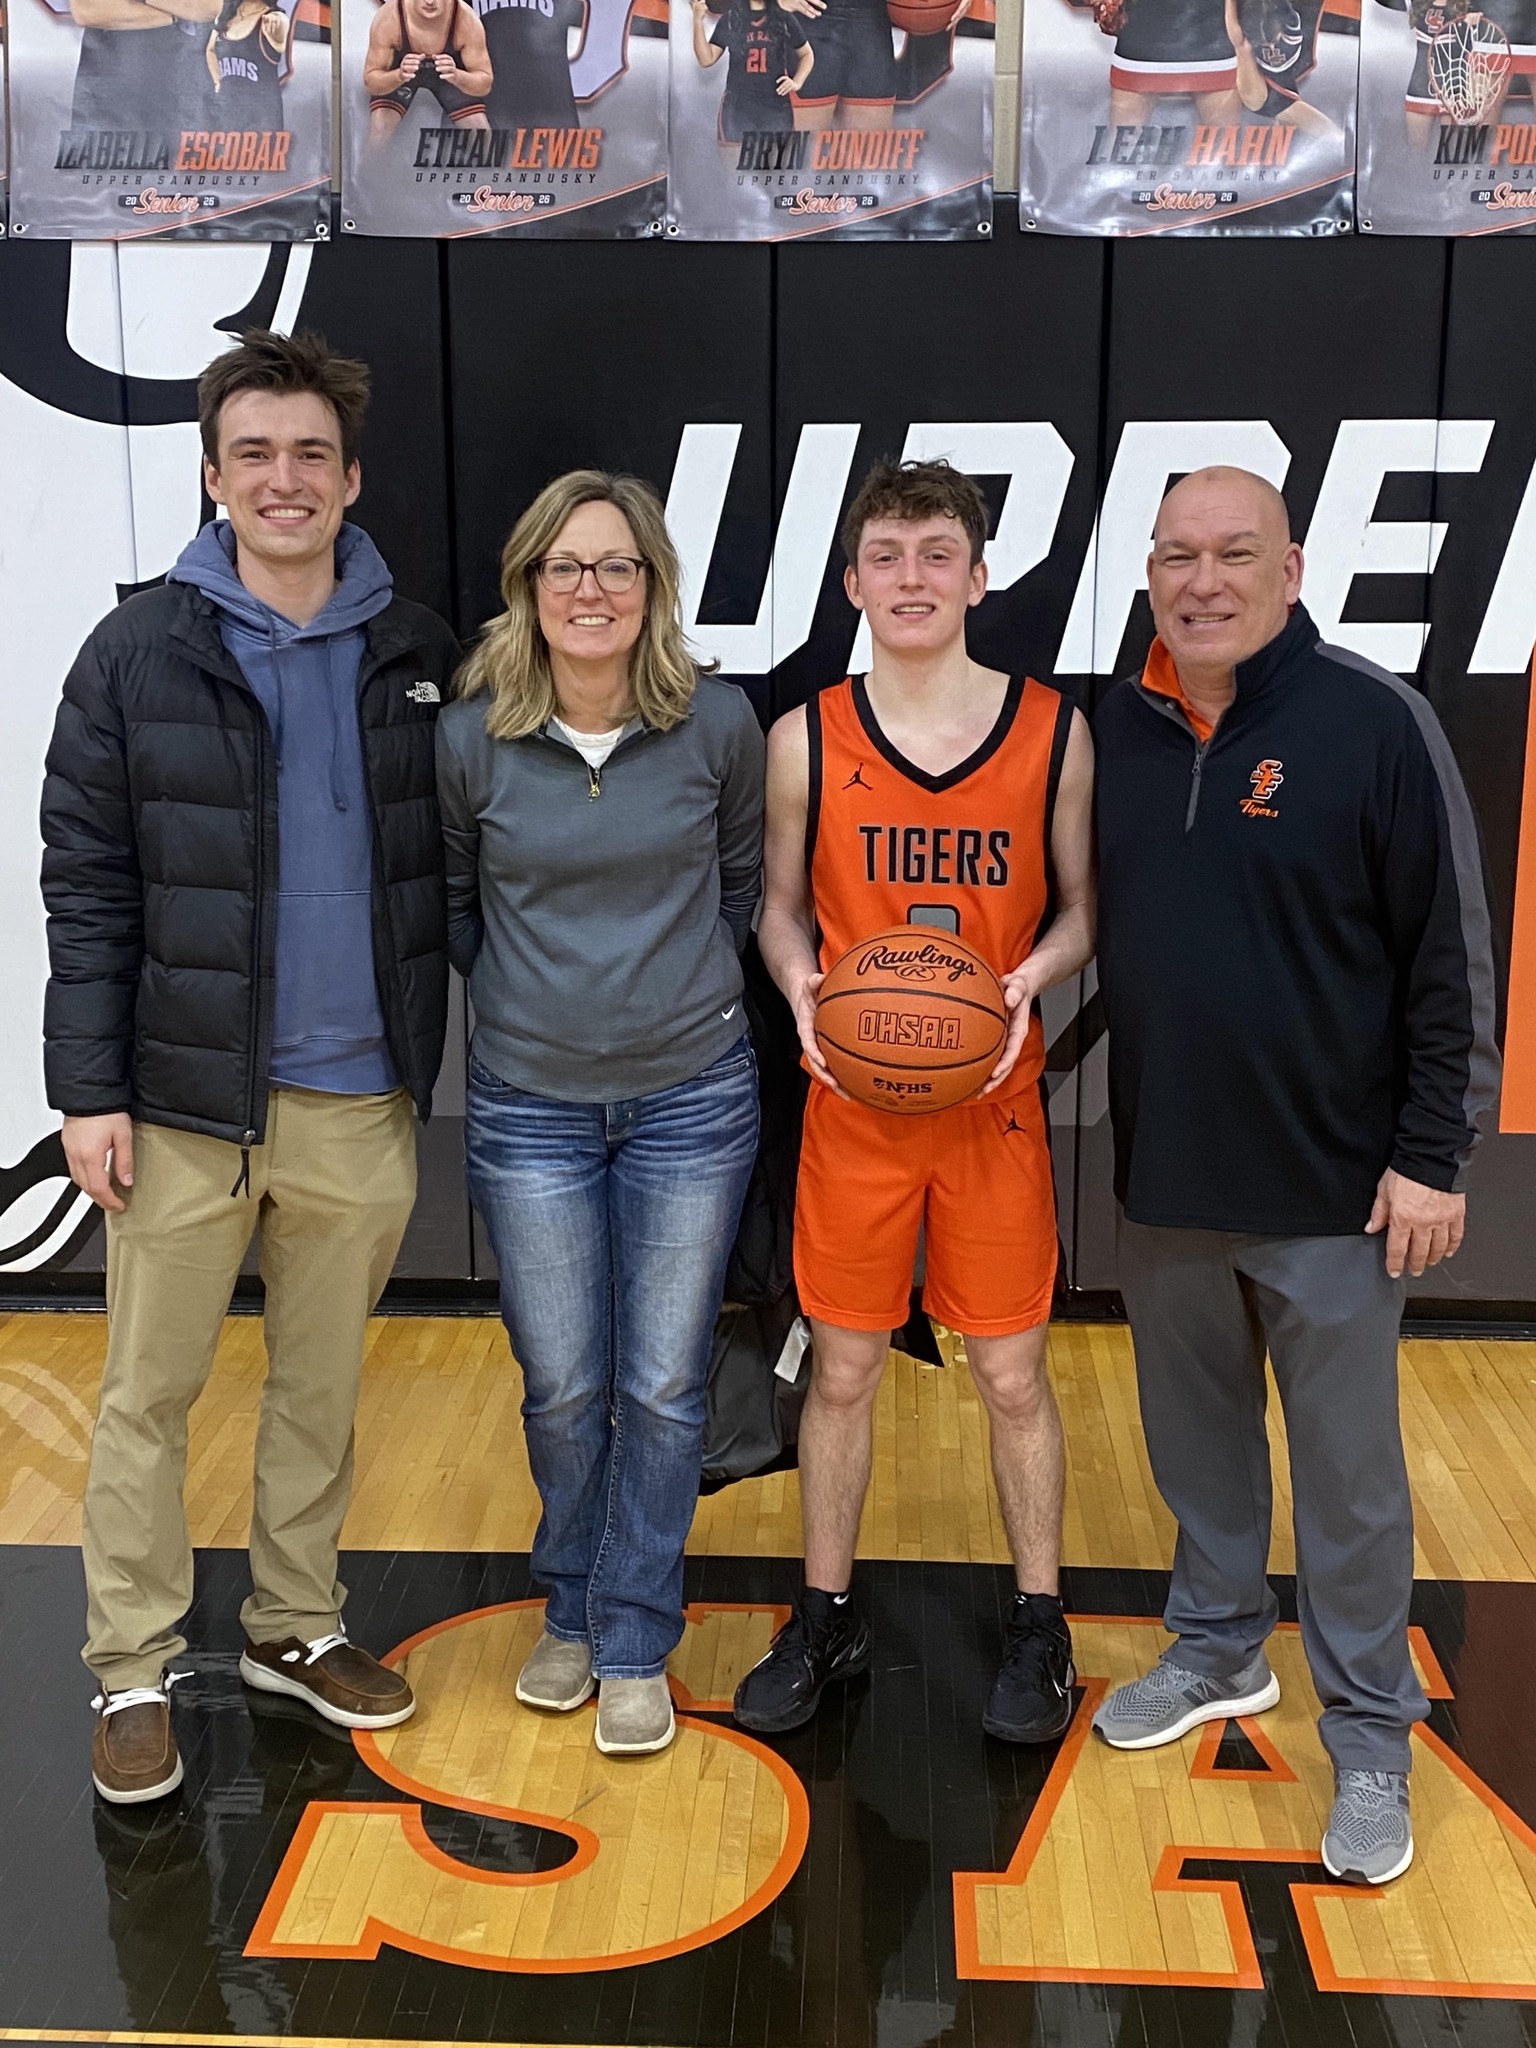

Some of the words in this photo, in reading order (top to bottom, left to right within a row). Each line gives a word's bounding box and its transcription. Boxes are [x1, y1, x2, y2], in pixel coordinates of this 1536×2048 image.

[746, 47, 767, 73] 21
[174, 131, 291, 172] ESCOBAR
[413, 128, 509, 168] ETHAN
[511, 128, 602, 170] LEWIS
[736, 130, 810, 171] BRYN
[811, 129, 924, 172] CUNDIFF
[1085, 125, 1186, 165] LEAH
[1185, 124, 1297, 166] HAHN
[1433, 124, 1490, 165] KIM
[82, 175, 143, 185] UPPER
[157, 175, 261, 186] SANDUSKY
[415, 172, 477, 183] UPPER
[492, 173, 597, 184] SANDUSKY
[736, 175, 799, 186] UPPER
[814, 174, 920, 185] SANDUSKY
[1433, 169, 1496, 180] UPPER
[125, 196, 137, 206] 20
[132, 187, 200, 215] Senior
[203, 197, 215, 206] 26
[459, 194, 471, 204] 20
[466, 184, 535, 213] Senior
[538, 194, 550, 204] 26
[781, 197, 793, 206] 20
[789, 187, 858, 216] Senior
[861, 197, 873, 206] 26
[1139, 193, 1151, 202] 20
[1146, 183, 1217, 211] Senior
[1220, 193, 1233, 202] 26
[1478, 191, 1491, 201] 20
[664, 418, 1536, 675] UPPE
[1239, 798, 1279, 818] Tigers
[858, 825, 1011, 887] TIGERS
[856, 944, 977, 981] Rawlings
[858, 1009, 961, 1050] OHSAA
[886, 1080, 933, 1094] NFHS
